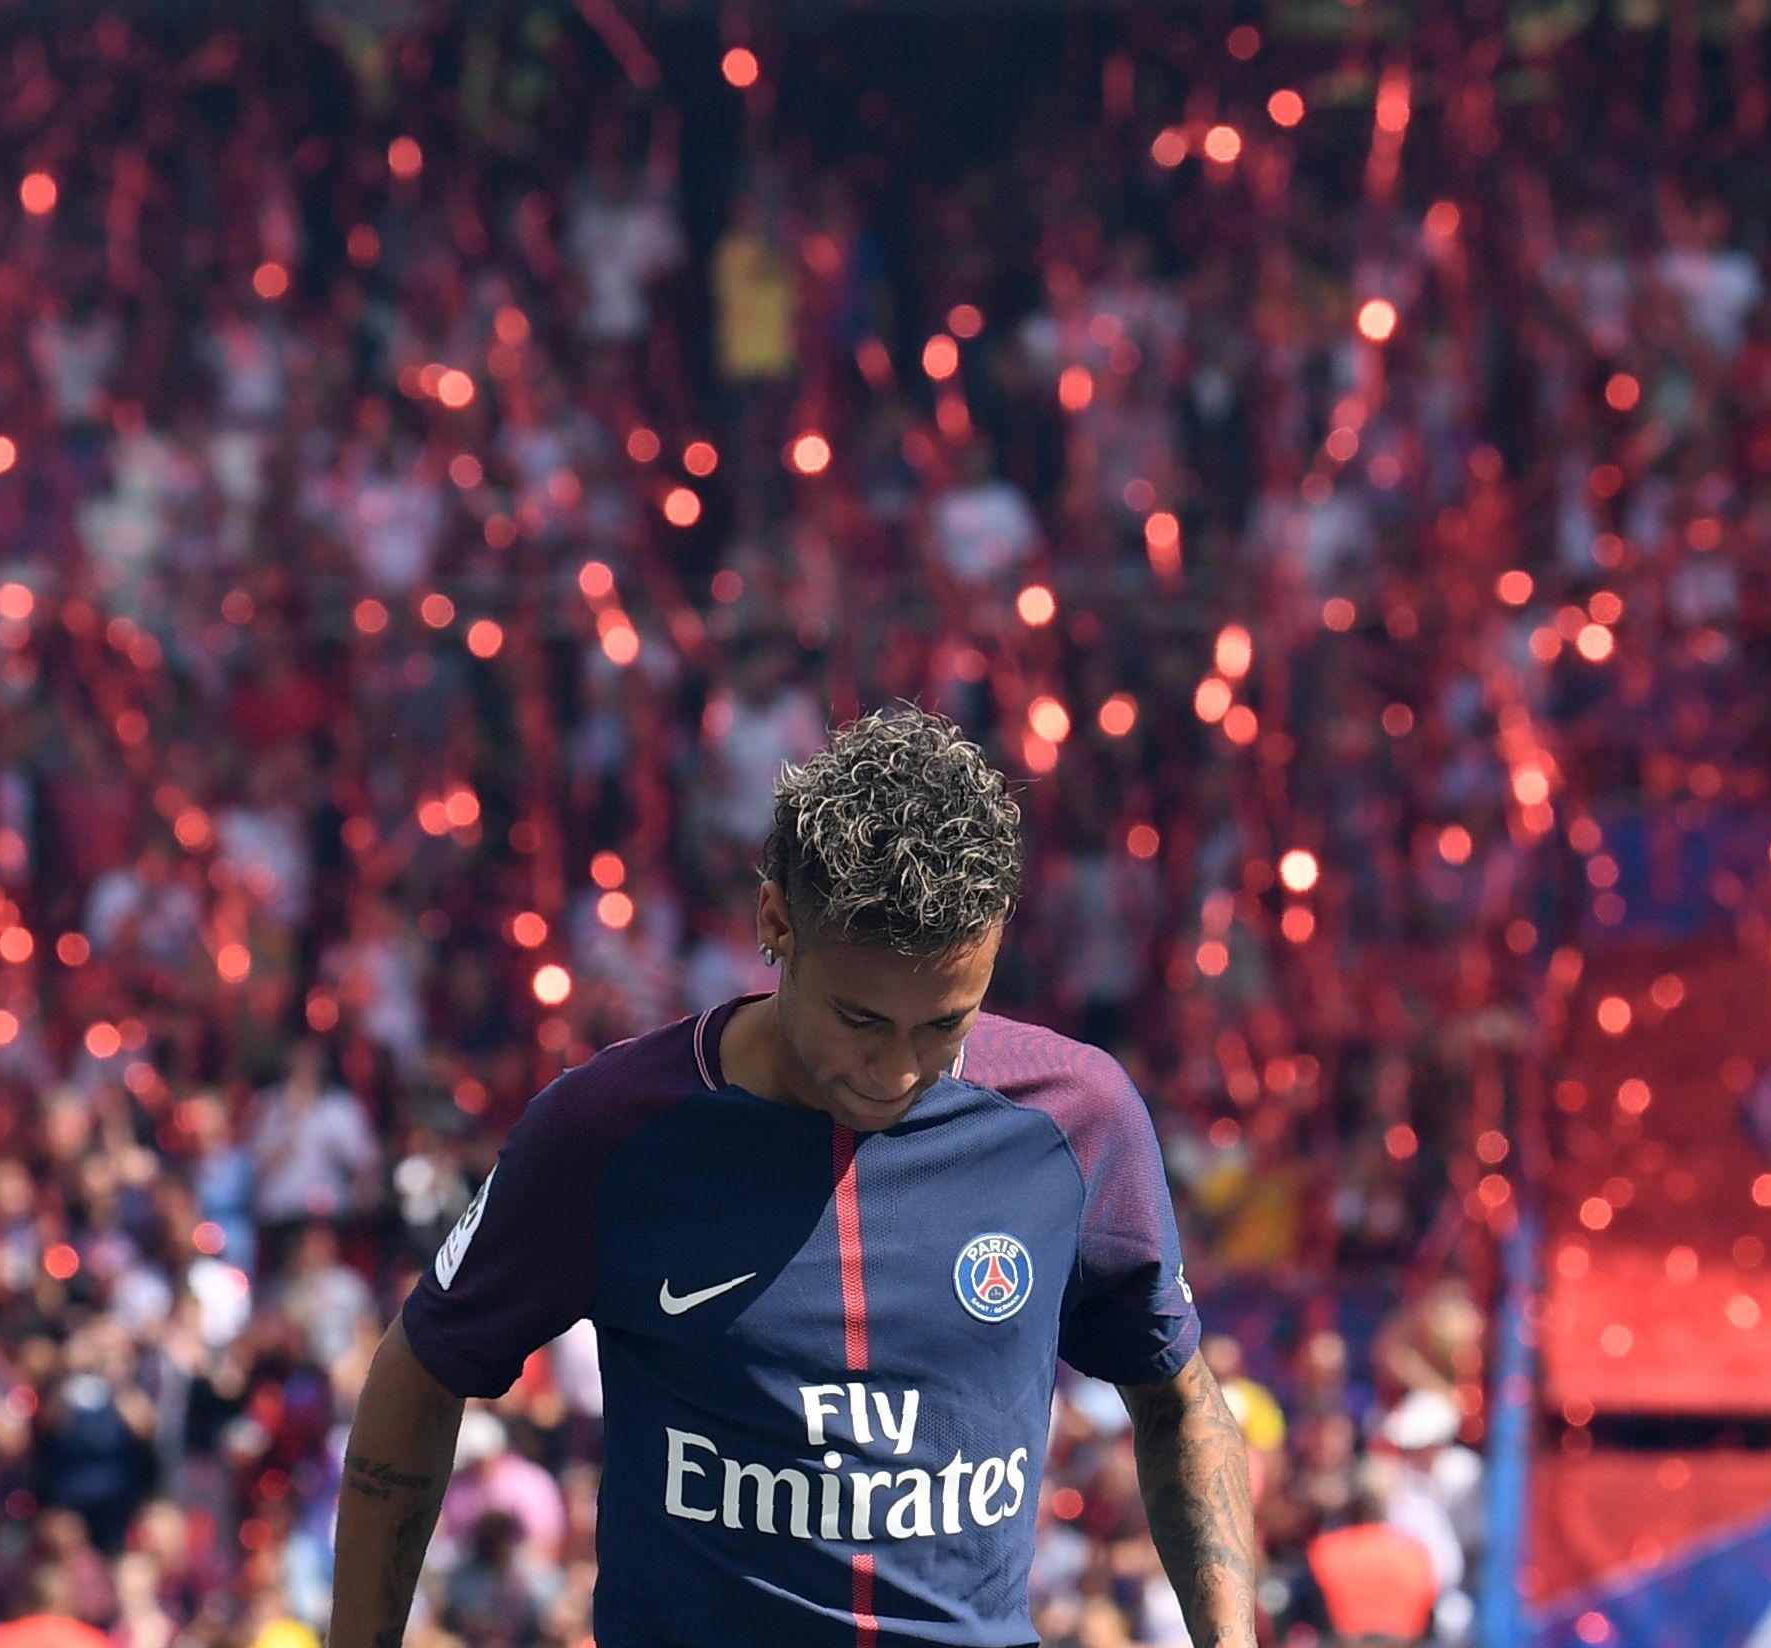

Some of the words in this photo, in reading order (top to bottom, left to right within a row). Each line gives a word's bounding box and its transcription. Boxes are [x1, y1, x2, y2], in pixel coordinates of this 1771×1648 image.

[966, 1239, 1019, 1262] PARIS
[798, 1382, 920, 1455] Fly
[664, 1426, 1028, 1541] Emirates
